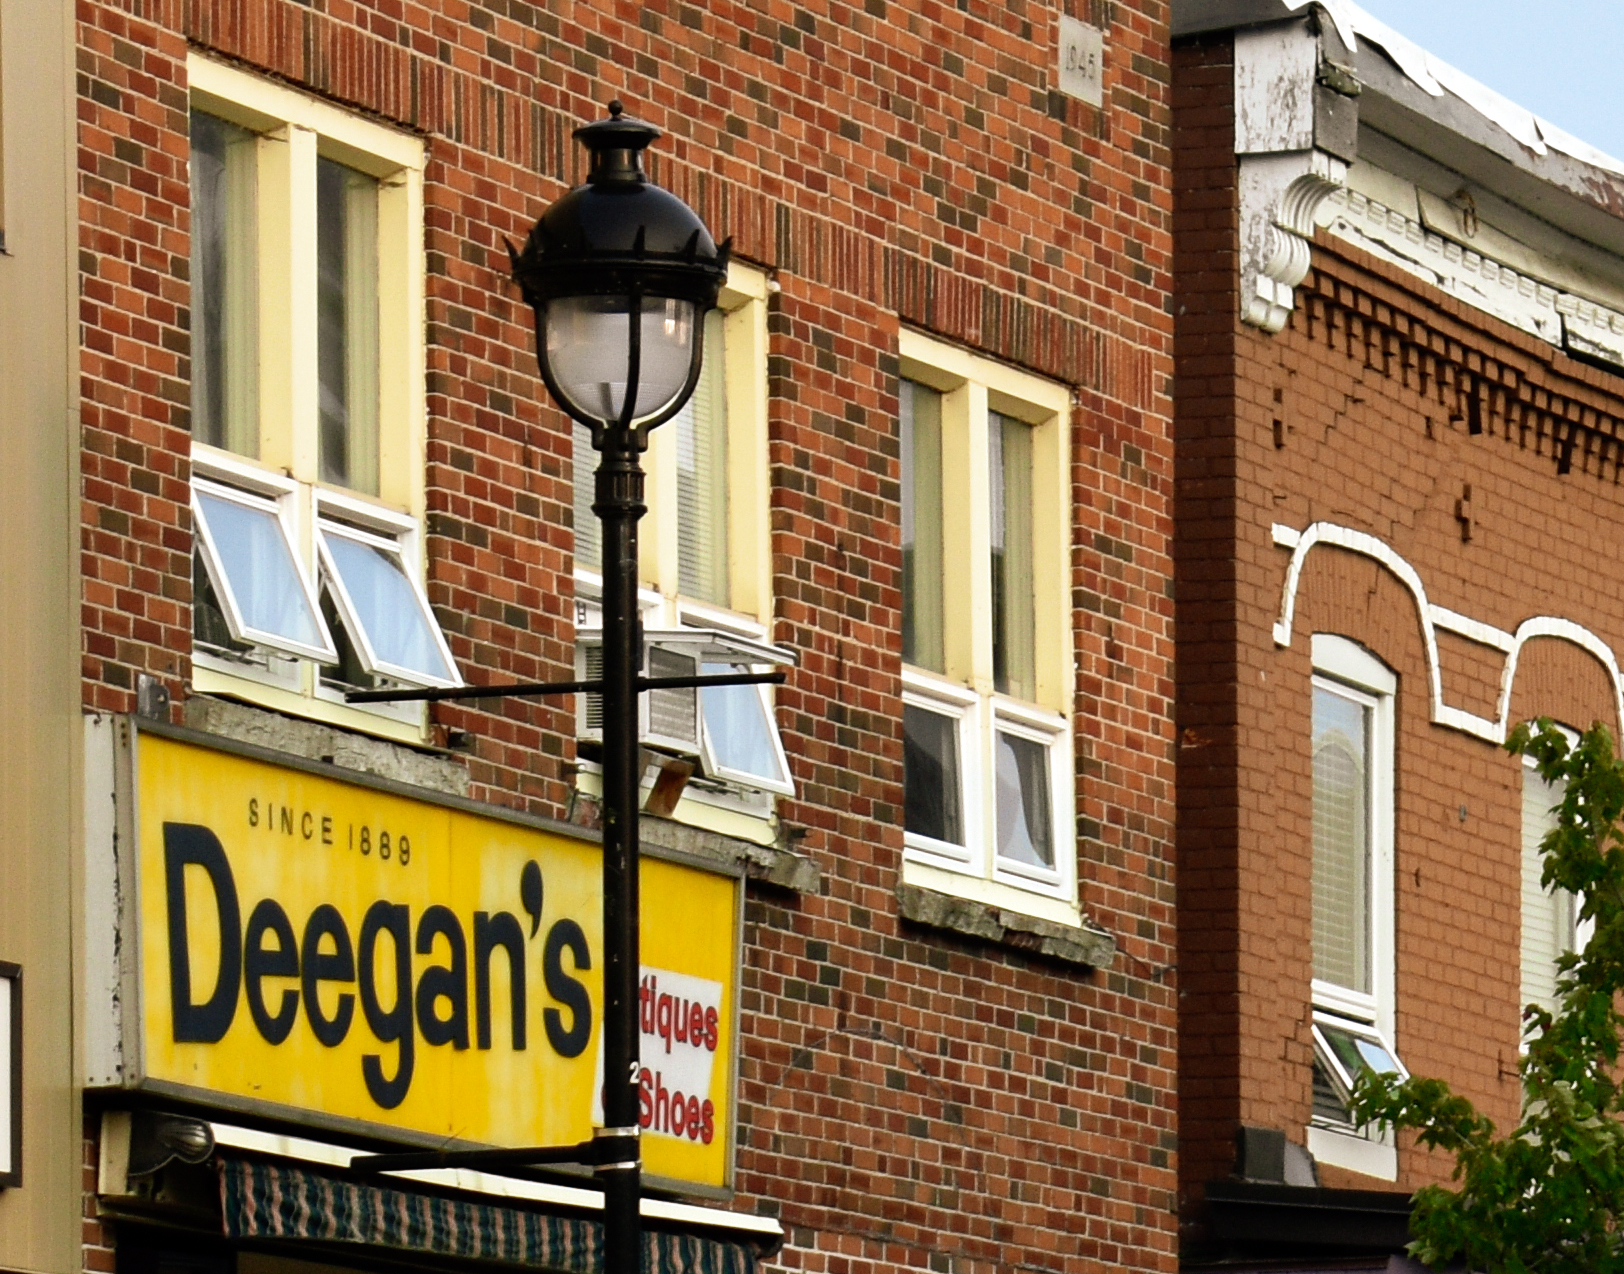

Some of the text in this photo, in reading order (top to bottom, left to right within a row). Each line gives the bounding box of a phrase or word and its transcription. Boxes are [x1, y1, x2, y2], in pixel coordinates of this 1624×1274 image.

[248, 798, 411, 866] SINCE 1889
[163, 821, 591, 1109] Deegan's
[639, 974, 719, 1054] tiques
[638, 1066, 714, 1145] Shoes
